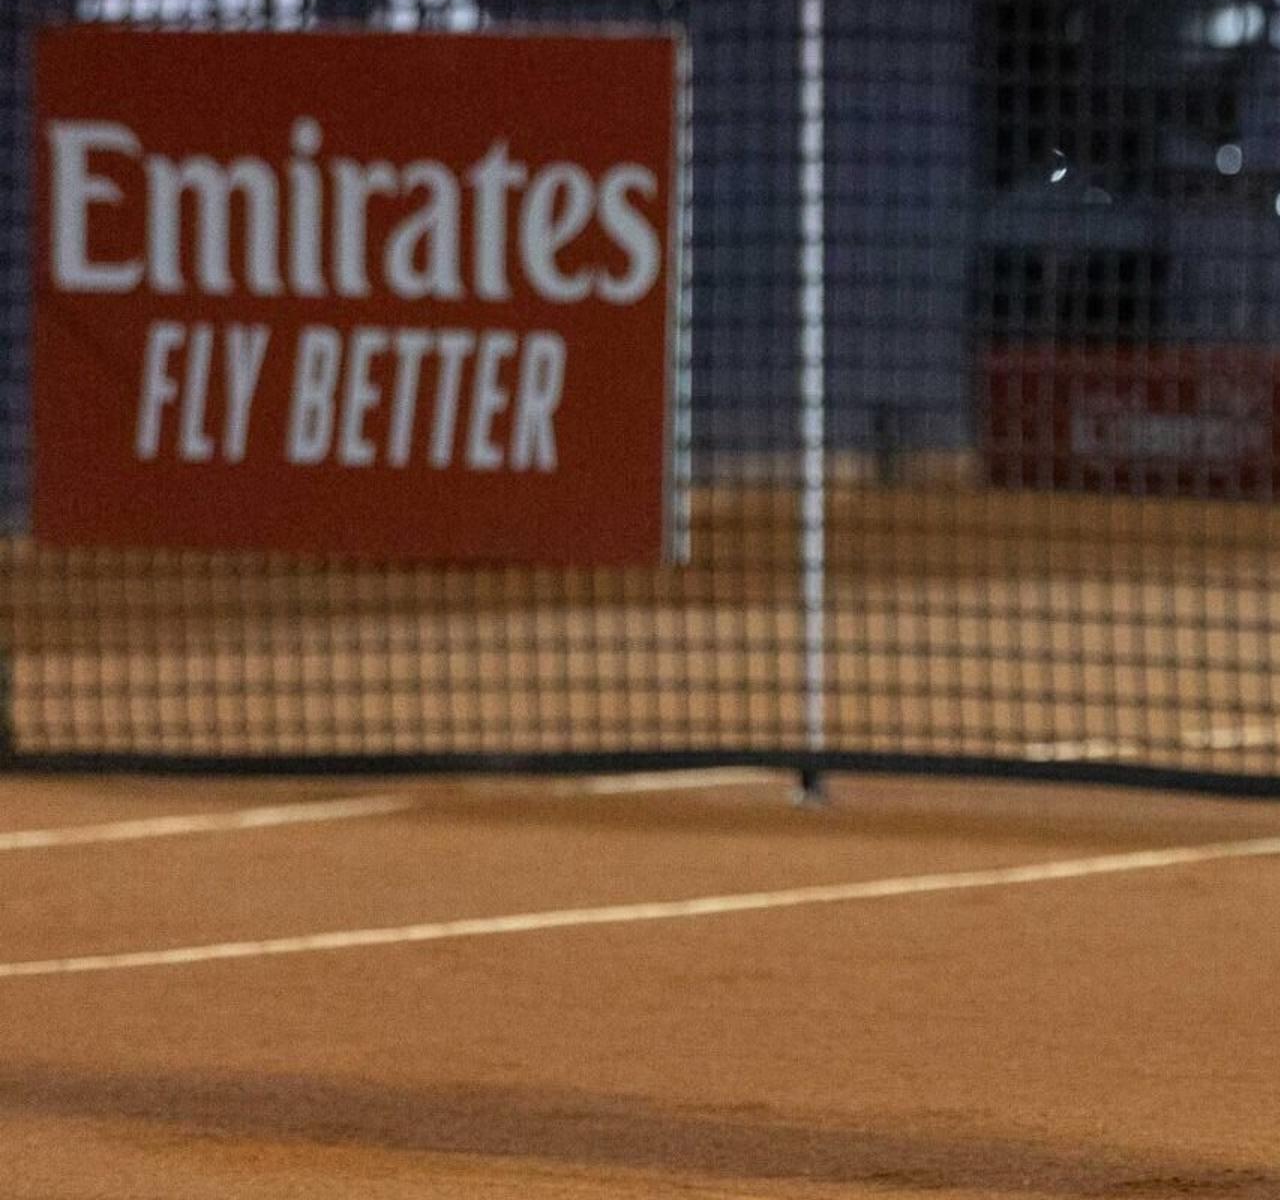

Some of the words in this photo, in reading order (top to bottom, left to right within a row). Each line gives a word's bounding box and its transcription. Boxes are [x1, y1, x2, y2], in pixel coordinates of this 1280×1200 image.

[49, 116, 662, 303] Emirates
[134, 322, 270, 462] FLY
[287, 324, 567, 472] BETTER
